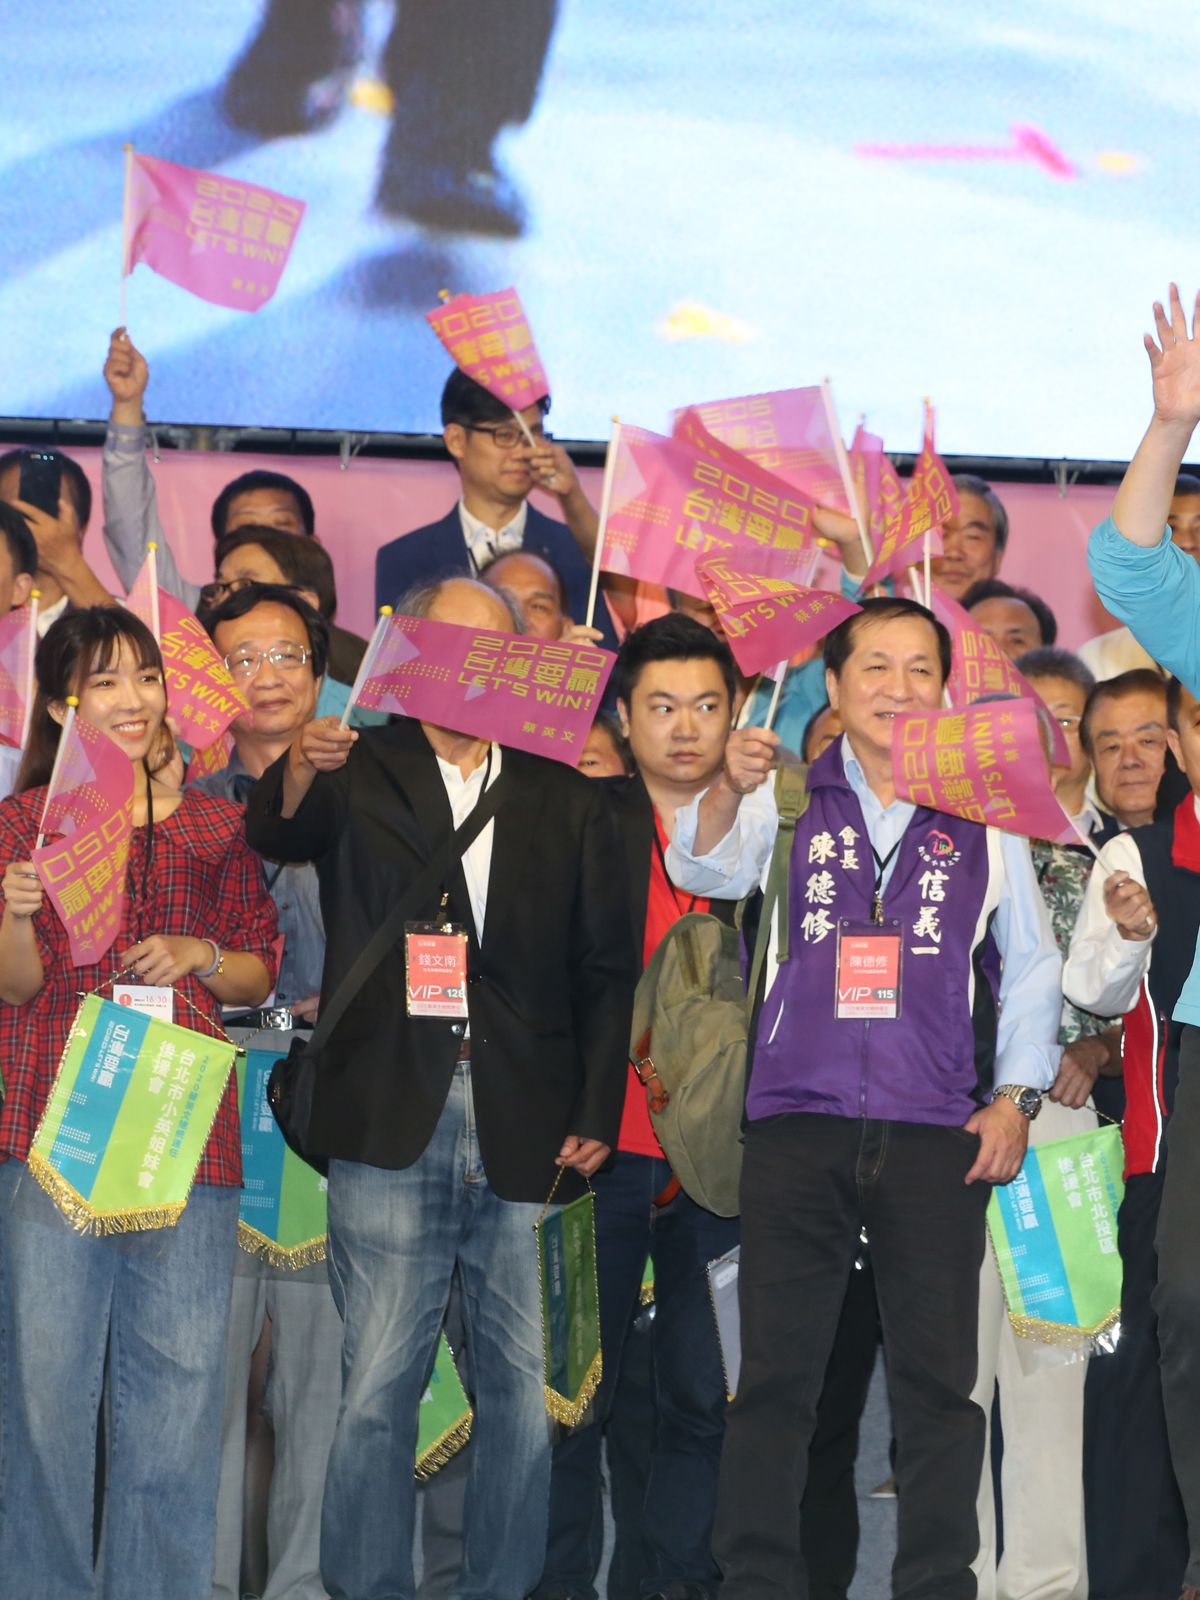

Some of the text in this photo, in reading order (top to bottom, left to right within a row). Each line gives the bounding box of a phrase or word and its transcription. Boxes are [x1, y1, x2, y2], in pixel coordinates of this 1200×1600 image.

[693, 460, 809, 526] 2020
[471, 635, 607, 668] 2020
[457, 671, 592, 711] LET'S WIN!
[463, 650, 602, 696] 台灣要贏
[191, 680, 241, 718] WIN!
[974, 712, 997, 769] WIN!
[838, 825, 860, 869] 會長
[801, 831, 838, 944] 陳德修
[911, 869, 949, 955] 信義一
[418, 953, 456, 967] 錢文南
[409, 985, 442, 999] VIP
[839, 986, 894, 1001] VIP 115
